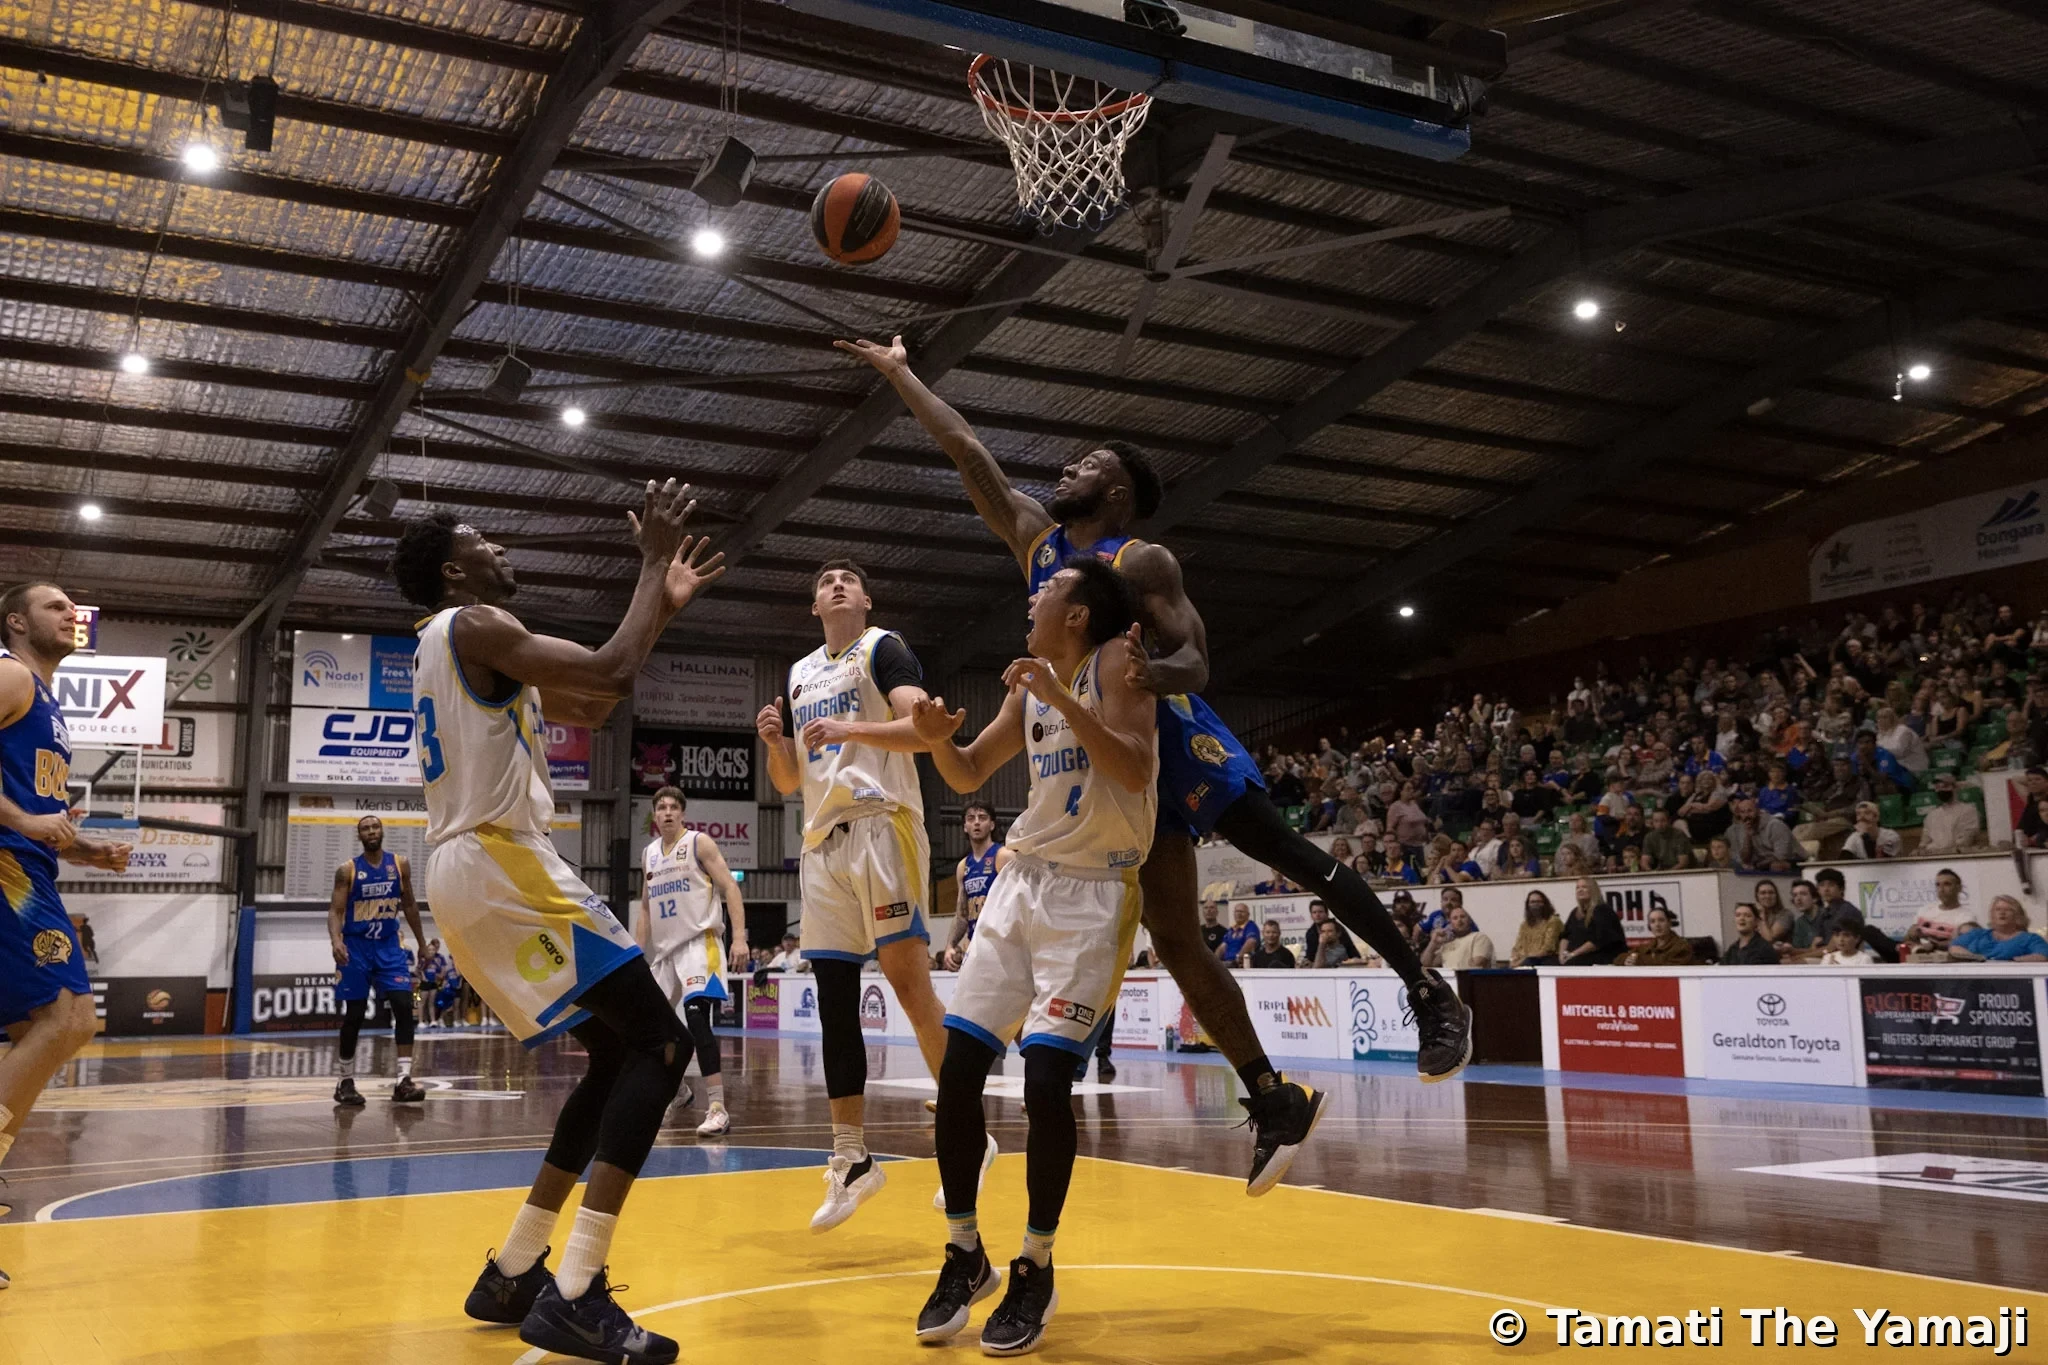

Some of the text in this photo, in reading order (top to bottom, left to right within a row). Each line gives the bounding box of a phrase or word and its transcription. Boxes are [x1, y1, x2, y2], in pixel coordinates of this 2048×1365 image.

[325, 671, 364, 682] Node1
[382, 667, 405, 678] Free
[58, 670, 145, 718] NIX
[794, 688, 861, 731] COUGARS
[69, 723, 138, 734] SOURCES
[323, 714, 414, 742] CJD
[415, 696, 446, 783] 3
[350, 748, 405, 758] EQUIPMENT
[680, 745, 749, 779] HOGS
[1032, 746, 1089, 779] COUGA
[680, 780, 749, 790] GERALDTON
[356, 799, 427, 811] Men's Divis
[1065, 785, 1082, 816] 4
[140, 829, 214, 846] DIESEL
[362, 881, 394, 898] FENIX
[648, 878, 690, 900] COUGARS
[659, 899, 677, 919] 12
[365, 921, 383, 939] 22
[295, 977, 336, 986] DREAM
[1978, 993, 2019, 1009] PROUD
[1562, 1004, 1675, 1020] MITCHELL & BROWN
[1968, 1011, 2033, 1026] SPONSORS
[1757, 1018, 1789, 1026] TOYOTA
[1281, 1032, 1308, 1040] GERALDTON
[1713, 1033, 1840, 1053] Geraldton Toyota
[1882, 1033, 2018, 1049] RIGTERS SUPERMARKET GROUP
